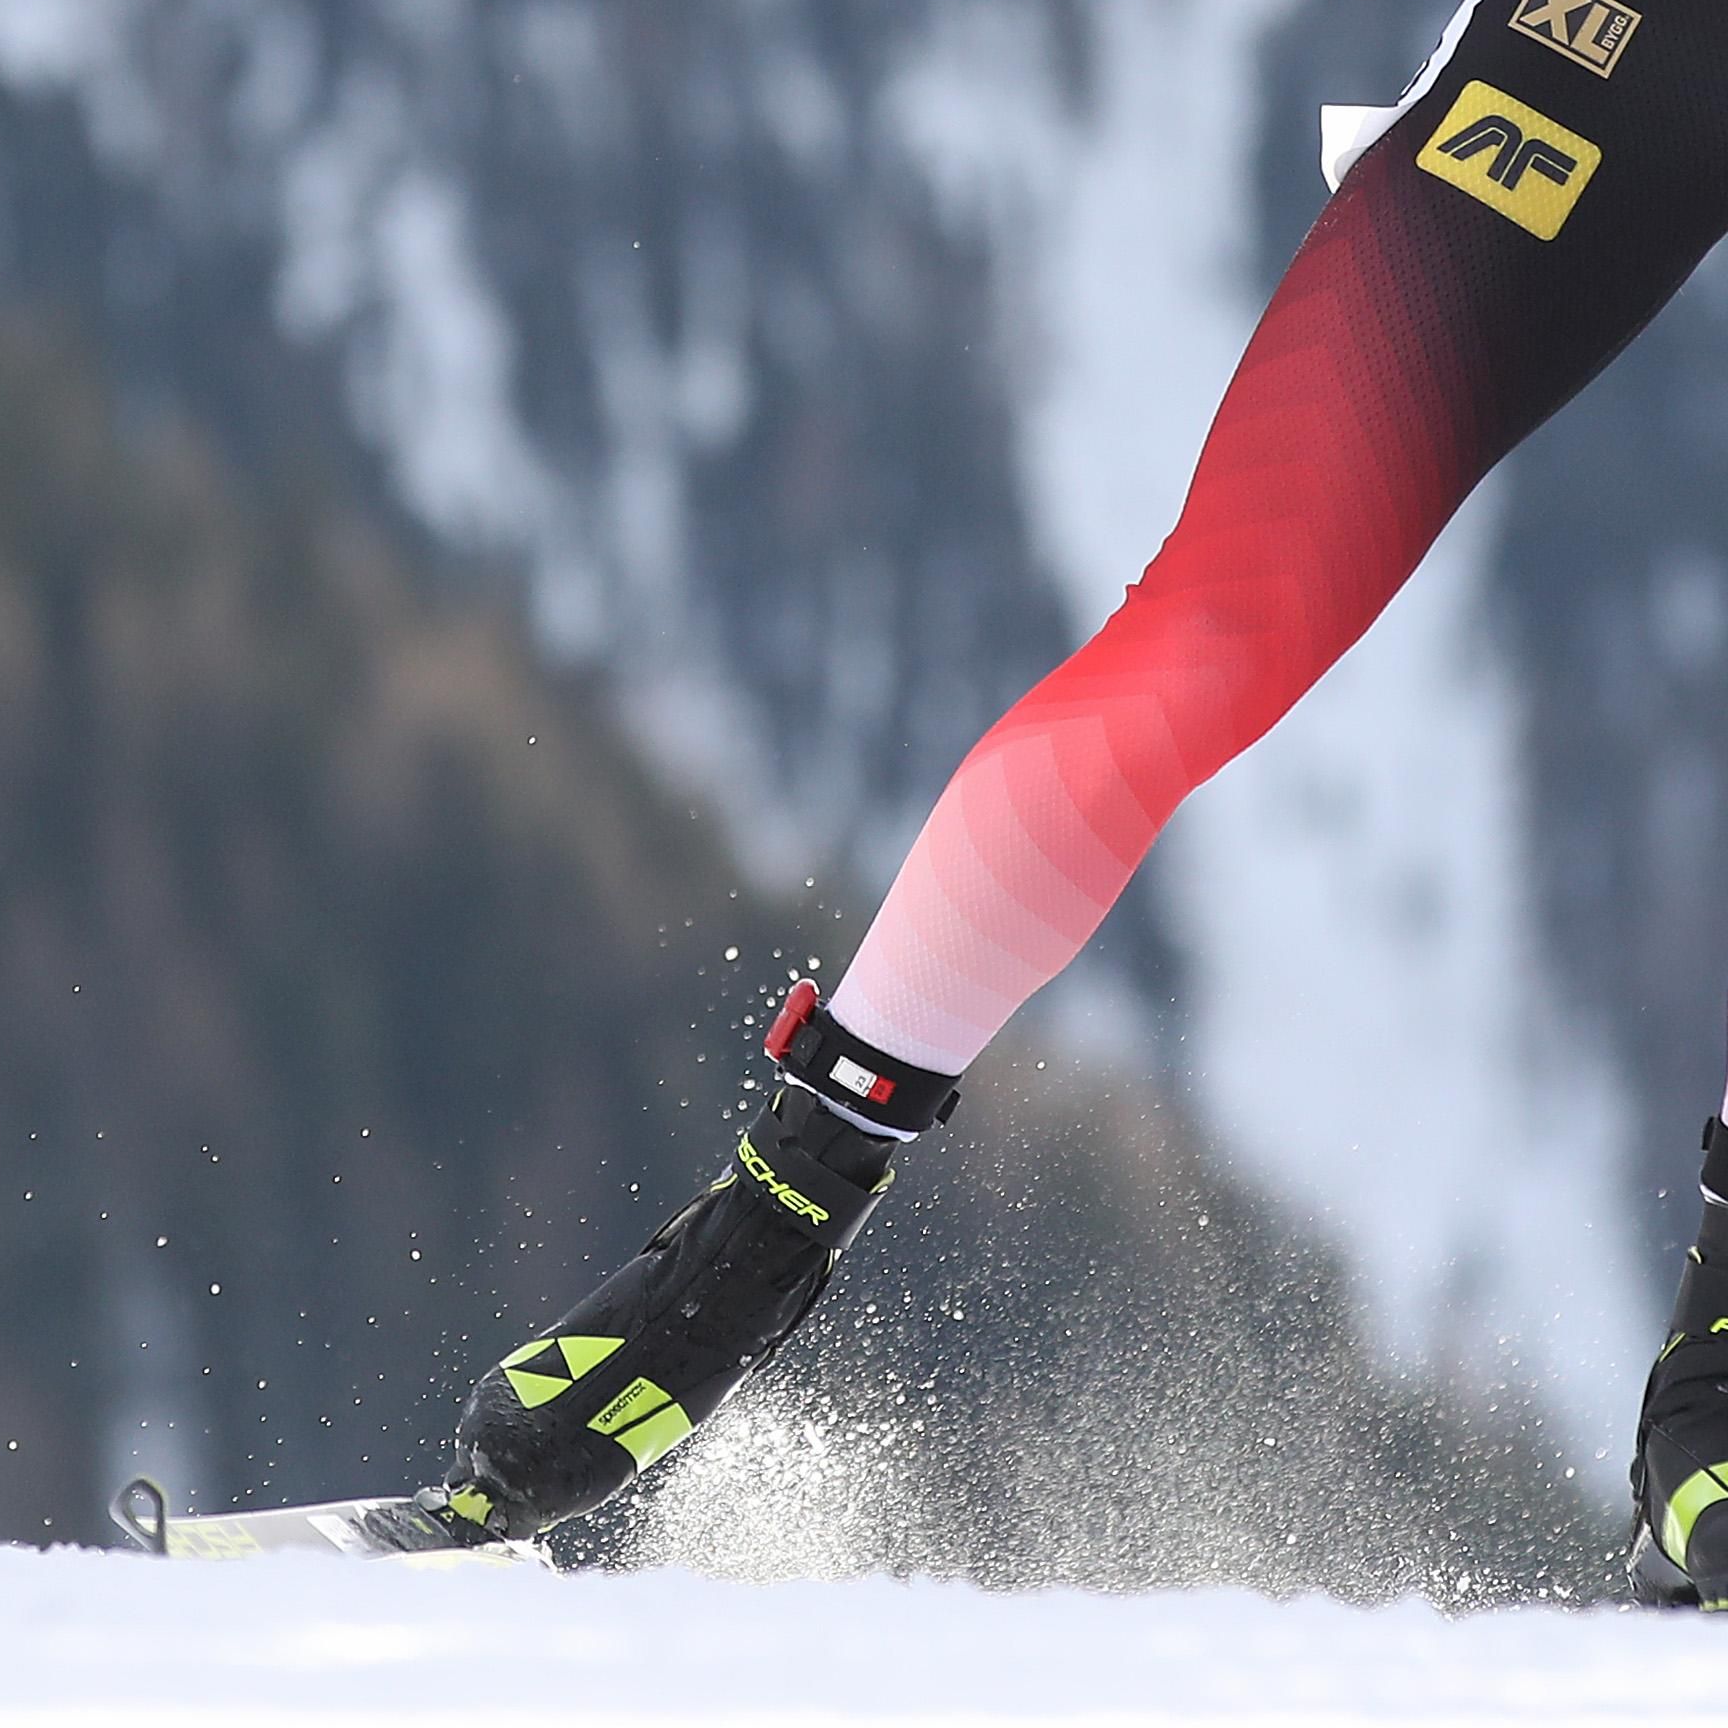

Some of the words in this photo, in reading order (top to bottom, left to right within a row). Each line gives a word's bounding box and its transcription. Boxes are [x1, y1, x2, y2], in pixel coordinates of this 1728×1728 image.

[1600, 14, 1628, 51] BYGG
[1437, 114, 1578, 192] AF
[738, 1133, 830, 1226] SCHER
